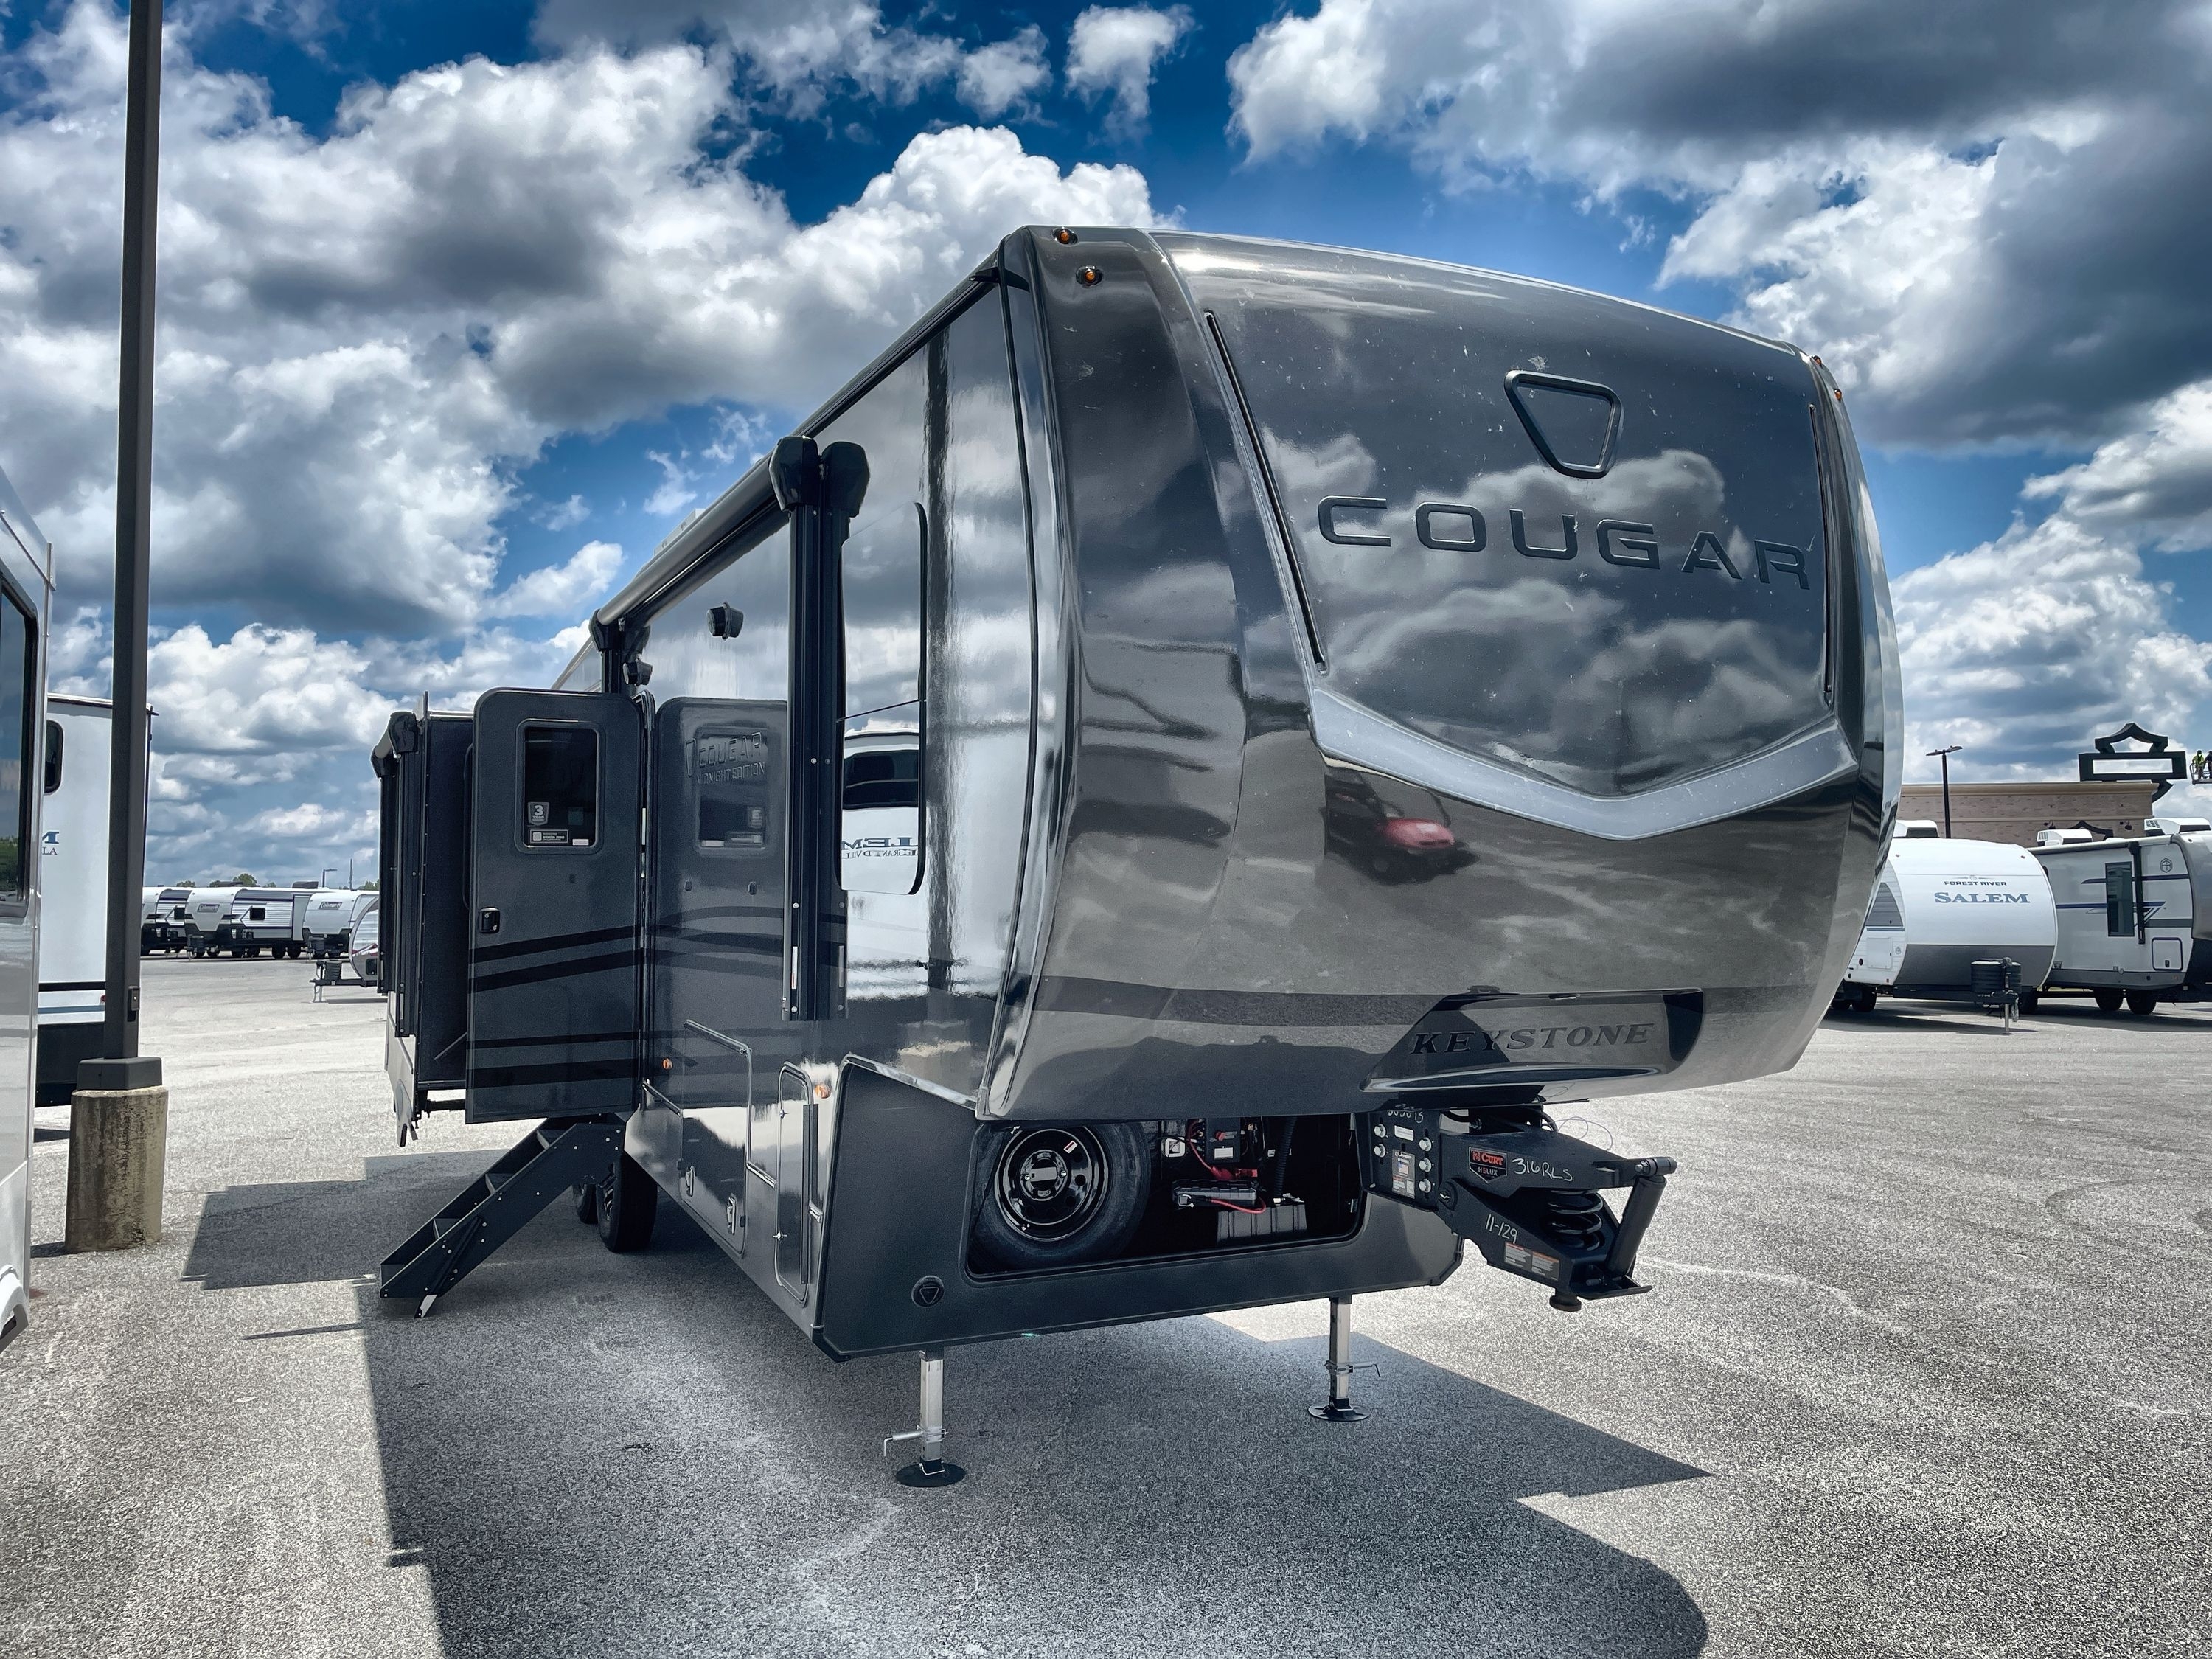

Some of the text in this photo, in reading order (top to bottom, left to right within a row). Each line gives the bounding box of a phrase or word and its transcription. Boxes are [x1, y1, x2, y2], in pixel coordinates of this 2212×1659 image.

[1318, 495, 1809, 590] COUGAR
[698, 732, 762, 768] COUGAR
[534, 804, 544, 816] 3
[1934, 891, 2031, 903] SALEM
[1409, 1023, 1655, 1055] KEYSTONE
[1481, 1152, 1503, 1166] CURT
[1512, 1158, 1574, 1182] 316RLS
[1485, 1214, 1518, 1245] 11-129
